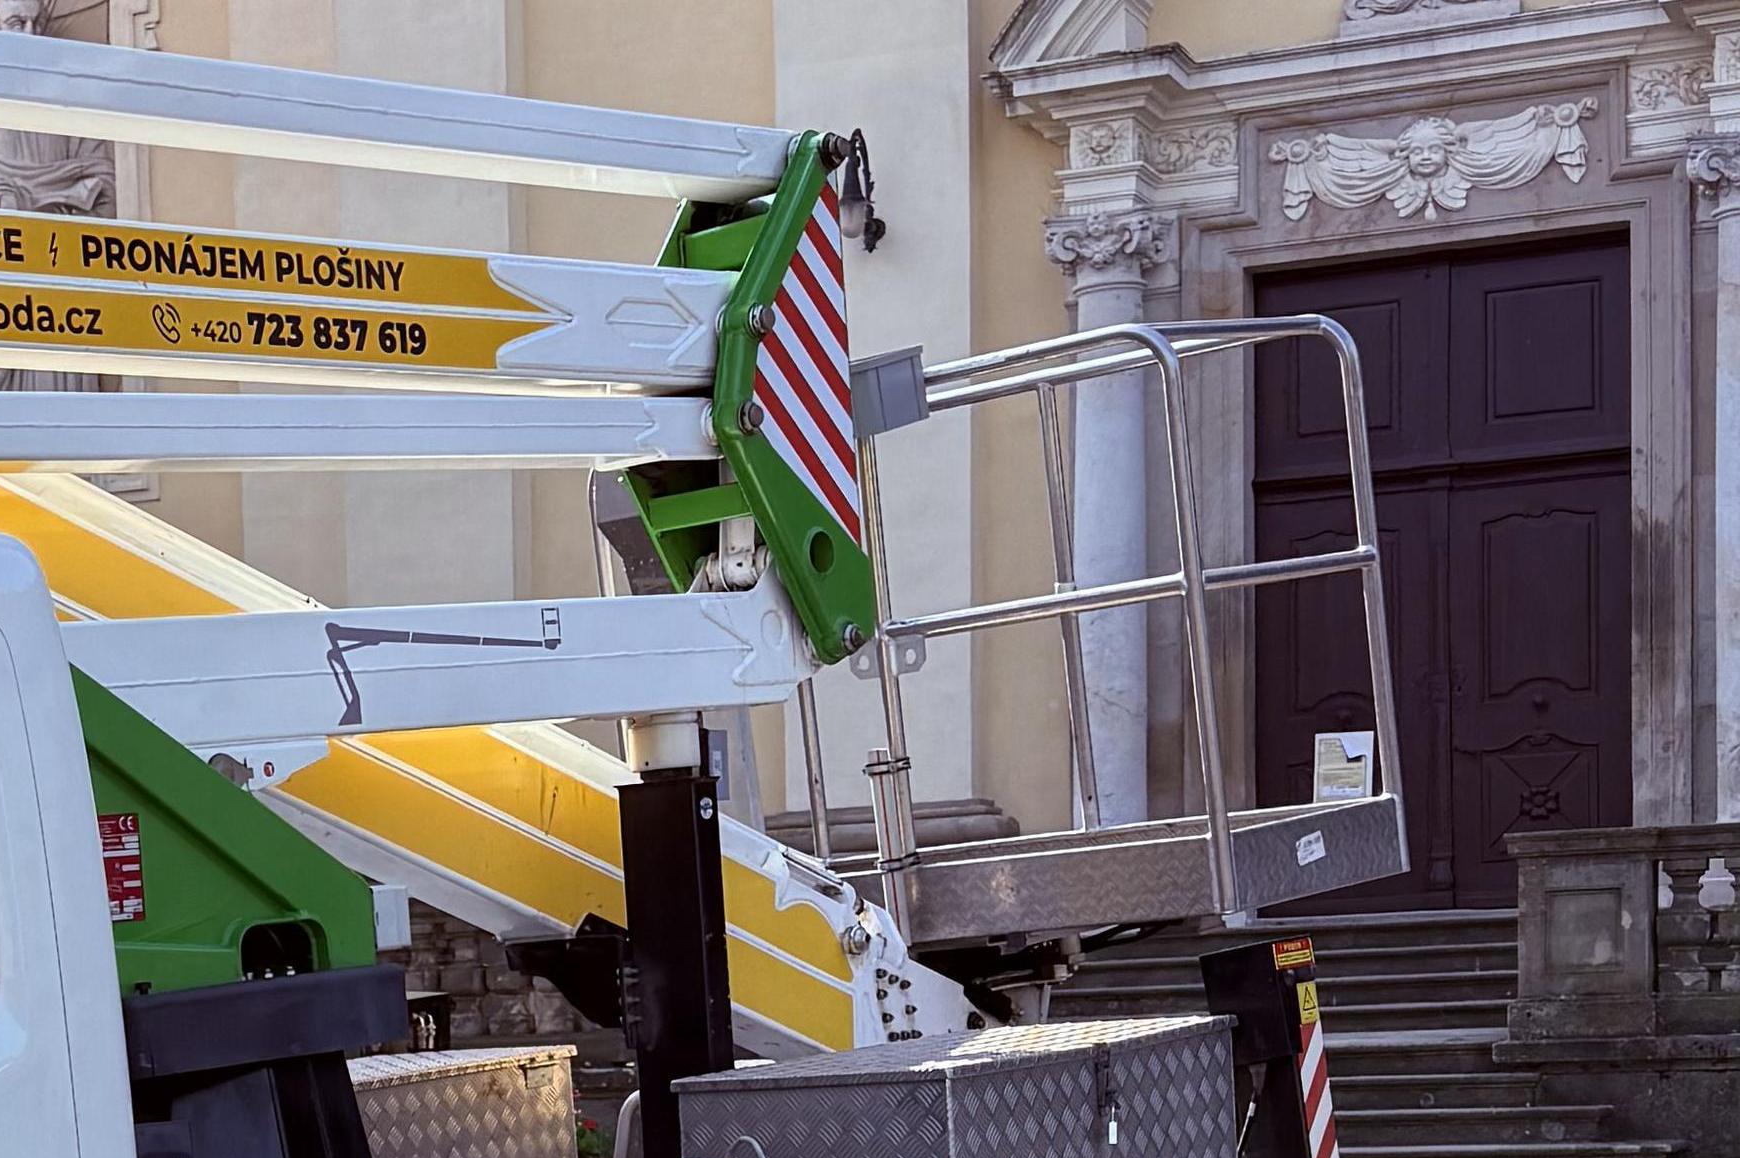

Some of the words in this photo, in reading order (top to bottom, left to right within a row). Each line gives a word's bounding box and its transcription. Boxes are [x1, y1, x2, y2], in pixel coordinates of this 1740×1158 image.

[81, 233, 265, 281] PRONÁJEM
[276, 247, 404, 292] PLOŠINY
[191, 319, 242, 344] +420
[247, 311, 304, 348] 723
[313, 315, 368, 352] 837
[378, 320, 427, 355] 619
